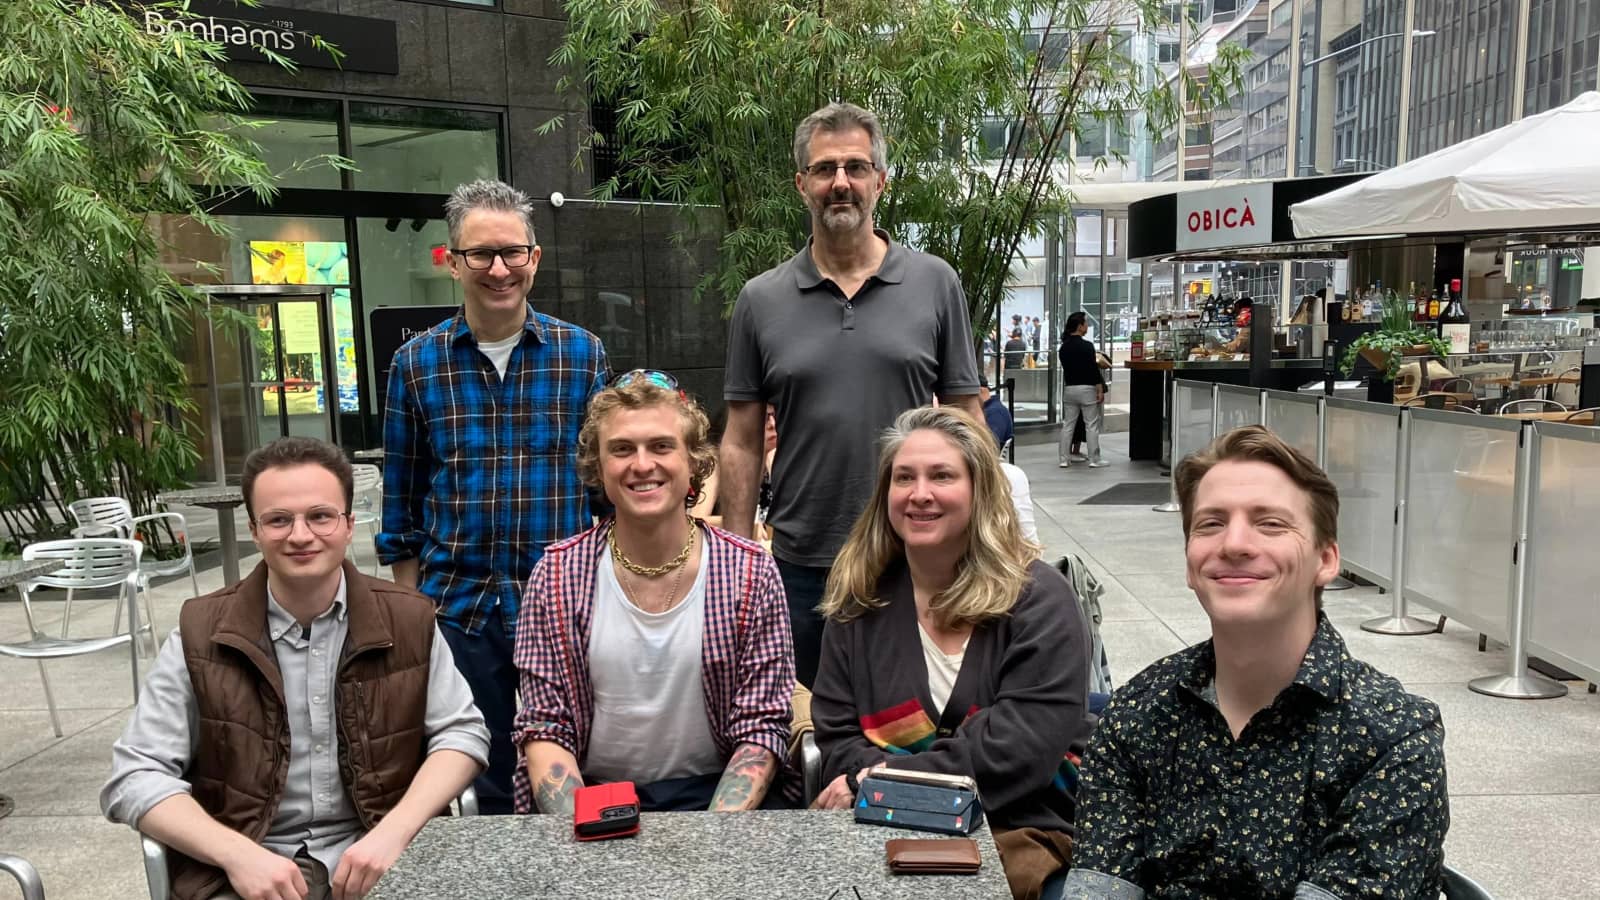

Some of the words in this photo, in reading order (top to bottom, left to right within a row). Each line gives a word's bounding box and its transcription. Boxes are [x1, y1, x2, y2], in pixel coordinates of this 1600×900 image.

[144, 11, 296, 51] Bonhams
[276, 20, 294, 29] 1793
[1187, 198, 1255, 233] OBICÀ
